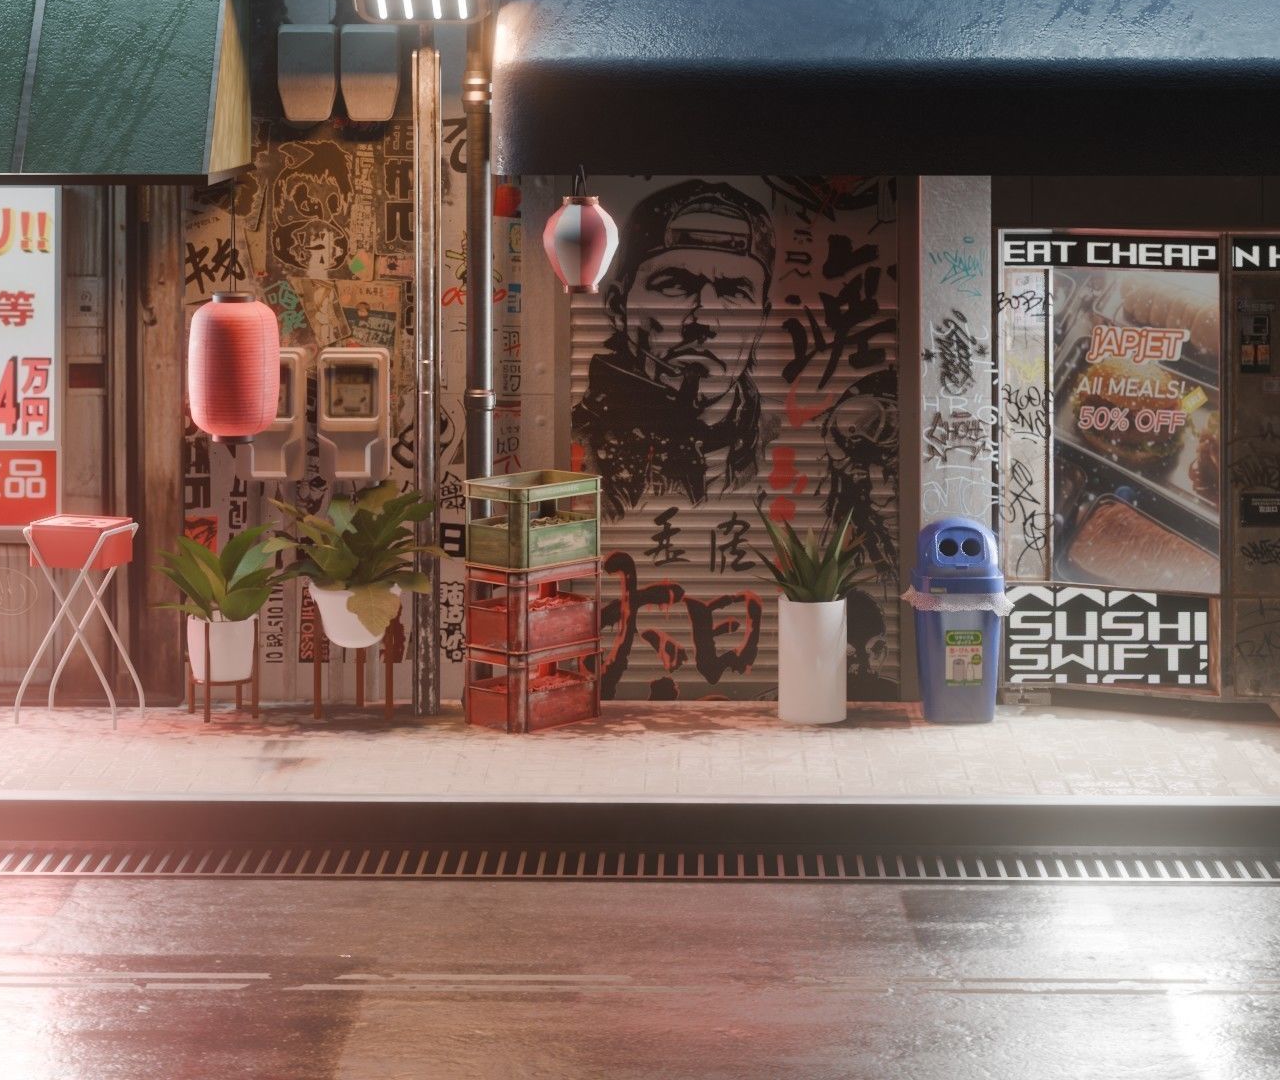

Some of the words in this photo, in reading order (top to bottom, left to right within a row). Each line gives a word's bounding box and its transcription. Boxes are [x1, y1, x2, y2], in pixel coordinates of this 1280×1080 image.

[1004, 241, 1077, 266] EAT
[1087, 242, 1217, 267] CHEAP
[1232, 246, 1260, 267] N
[1077, 379, 1103, 394] All
[1107, 378, 1186, 400] MEALS!
[1078, 407, 1129, 432] 50%
[1135, 409, 1186, 434] OFF
[1008, 610, 1208, 641] SUSHI
[1008, 643, 1208, 672] SWIFT!
